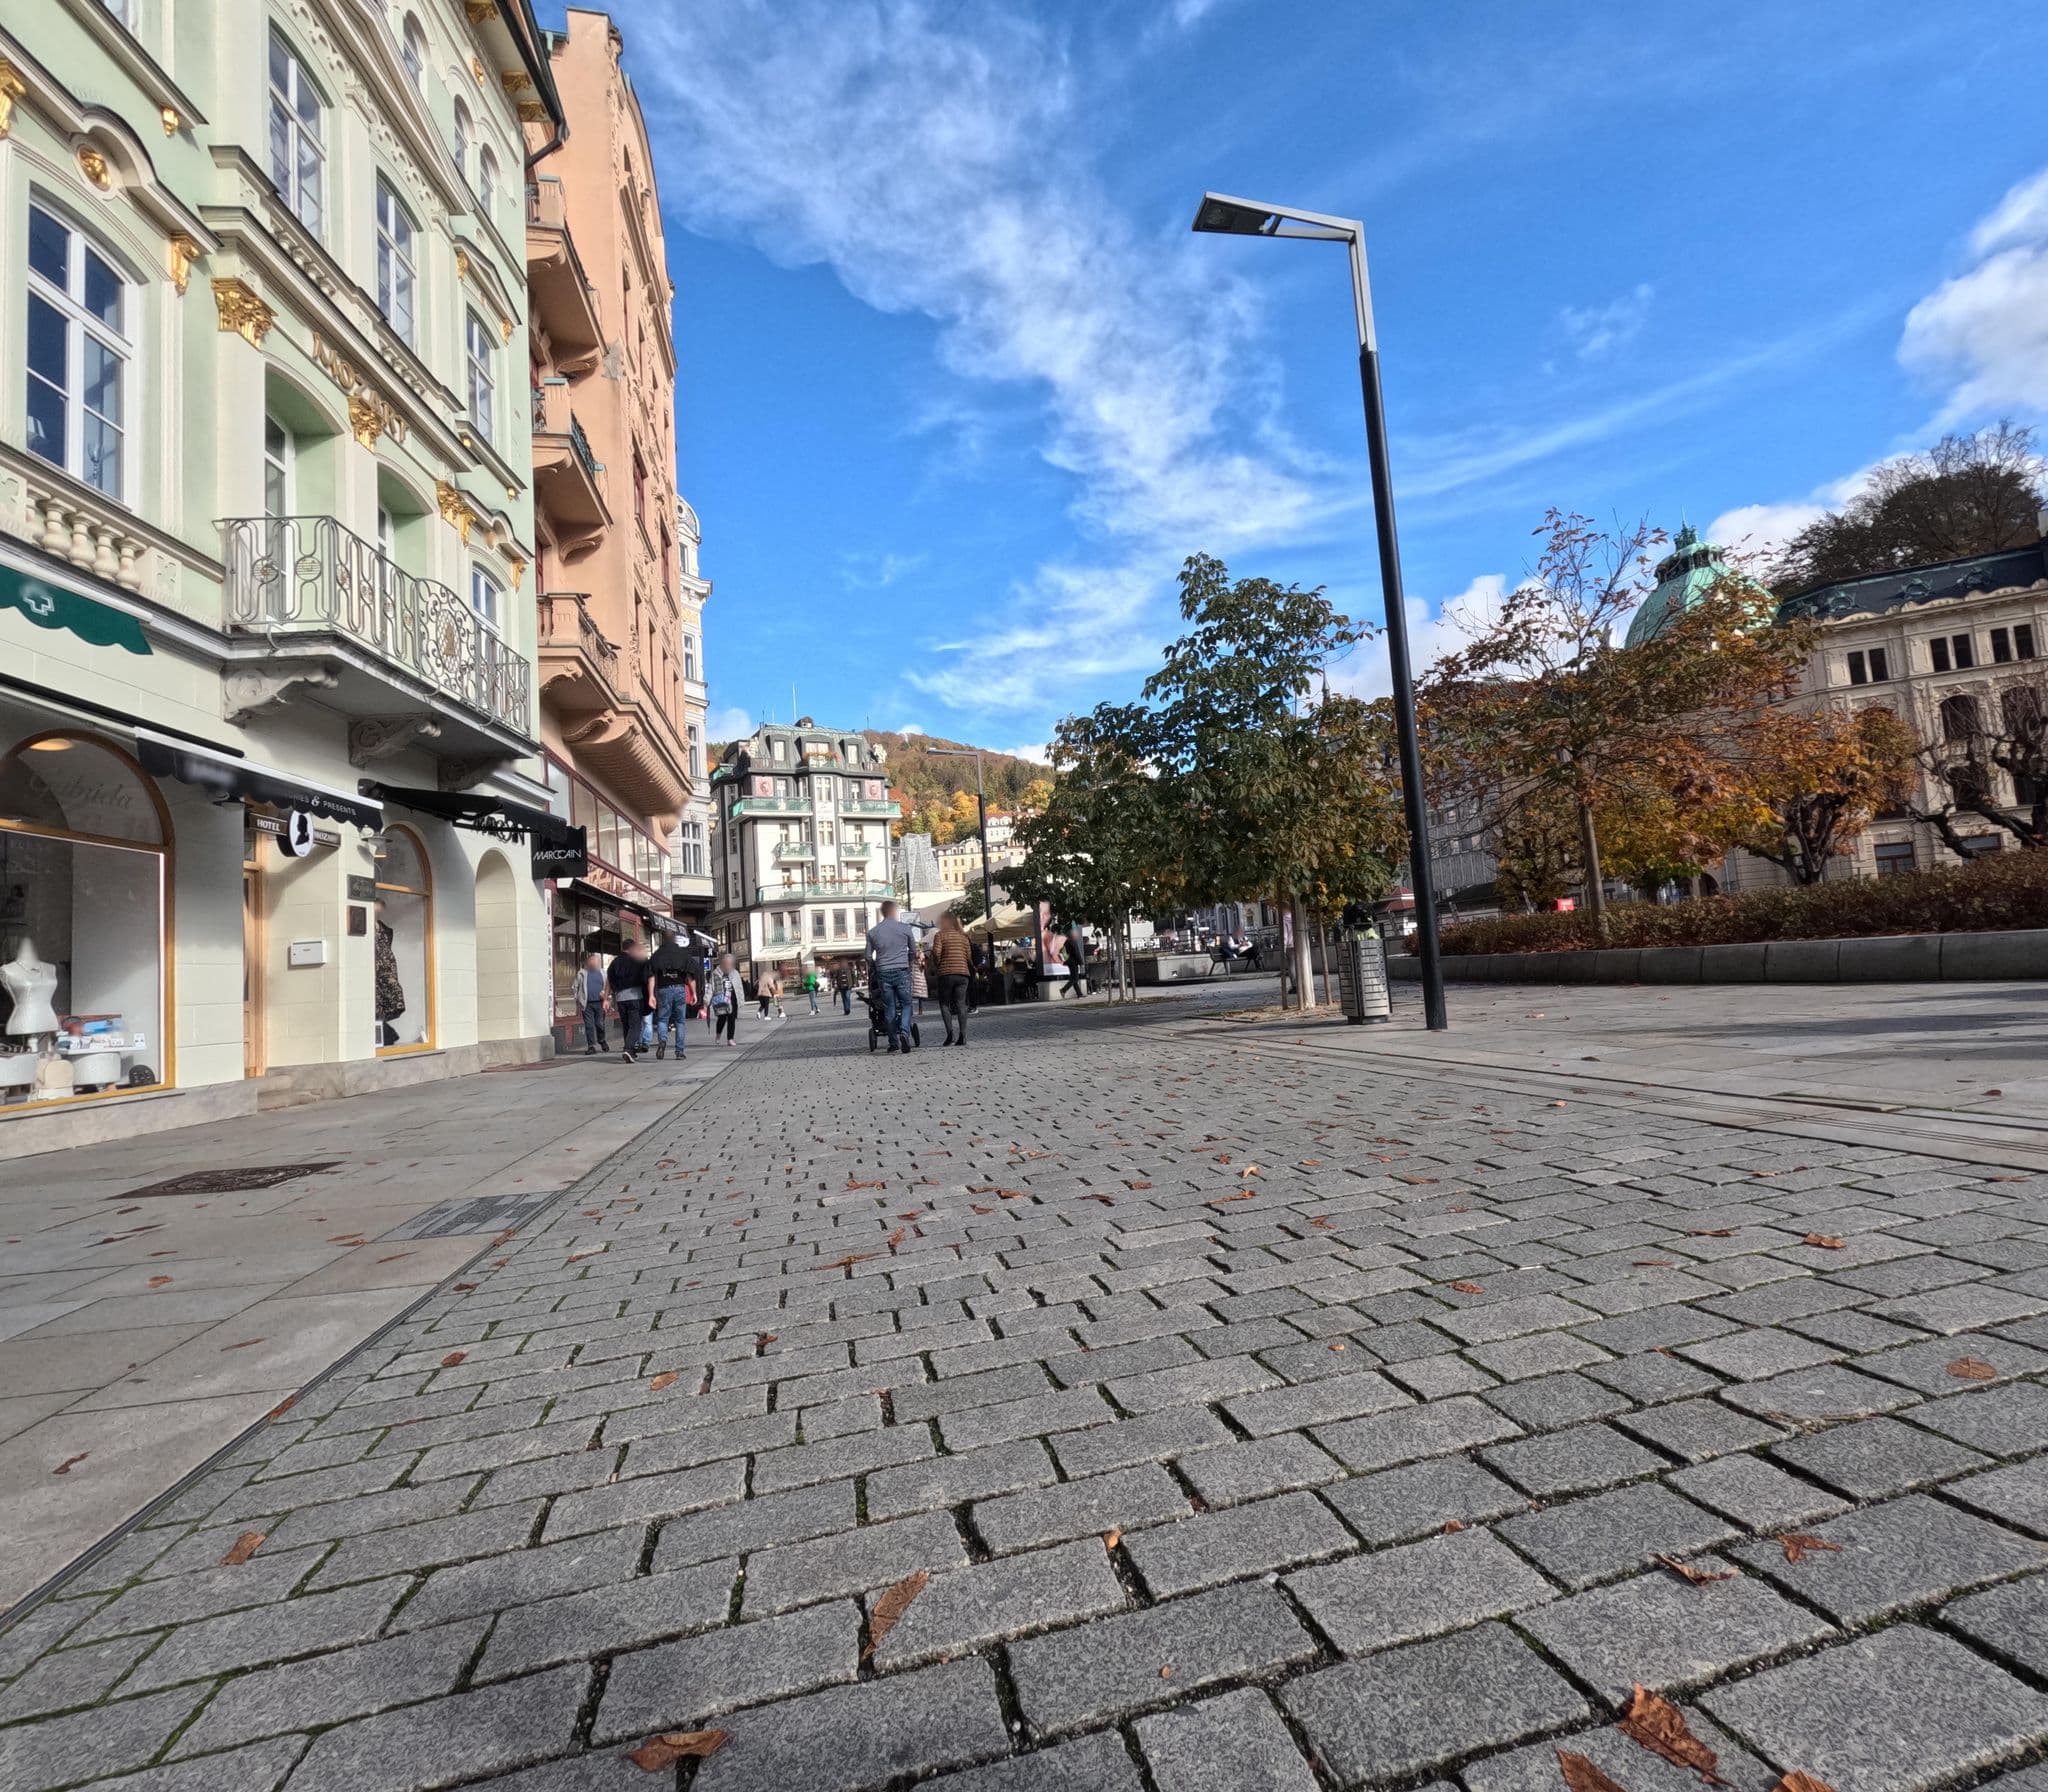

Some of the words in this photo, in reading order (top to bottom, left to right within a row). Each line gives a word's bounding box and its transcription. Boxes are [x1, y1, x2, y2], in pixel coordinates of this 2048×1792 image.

[311, 795, 320, 807] &
[323, 800, 357, 816] PRESENTS
[256, 818, 281, 832] HOTEL
